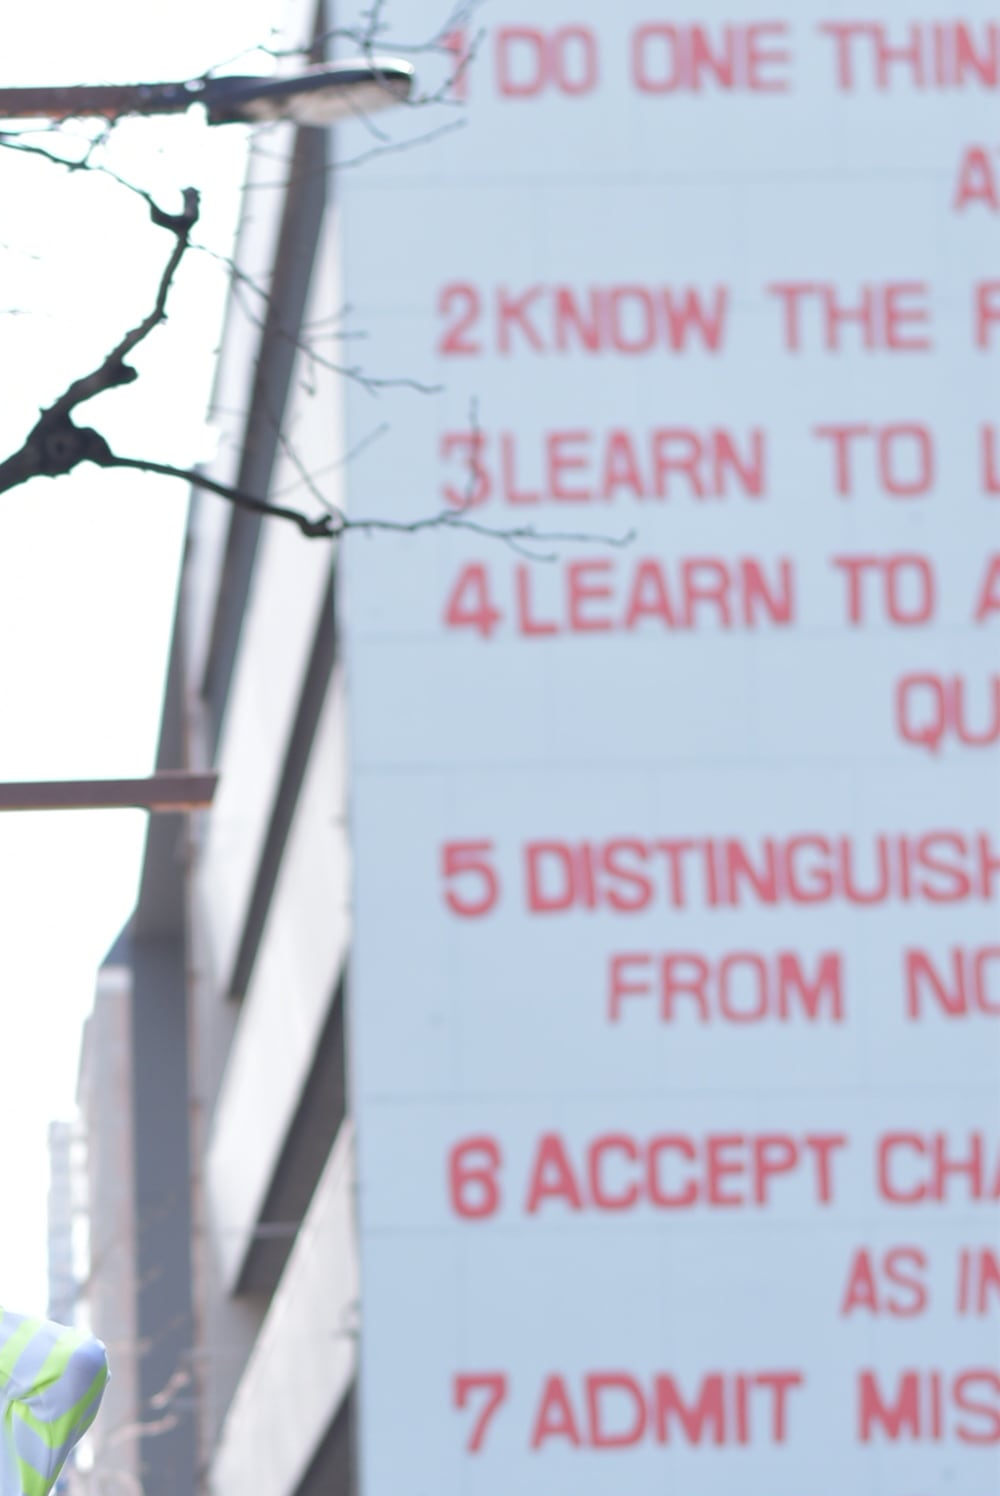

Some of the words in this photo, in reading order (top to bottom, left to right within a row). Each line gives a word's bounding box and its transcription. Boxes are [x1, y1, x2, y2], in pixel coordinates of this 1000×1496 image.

[493, 23, 599, 101] DO
[631, 21, 789, 95] ONE
[768, 280, 931, 352] THE
[814, 420, 936, 500] TO
[831, 552, 937, 627] TO
[440, 838, 501, 920] 5
[607, 950, 845, 1024] FROM
[447, 1134, 503, 1222] 6
[524, 1131, 847, 1215] ACCEPT
[875, 1130, 1000, 1206] CH
[841, 1245, 928, 1318] AS
[530, 1370, 804, 1450] ADMIT
[857, 1368, 1000, 1445] MIS
